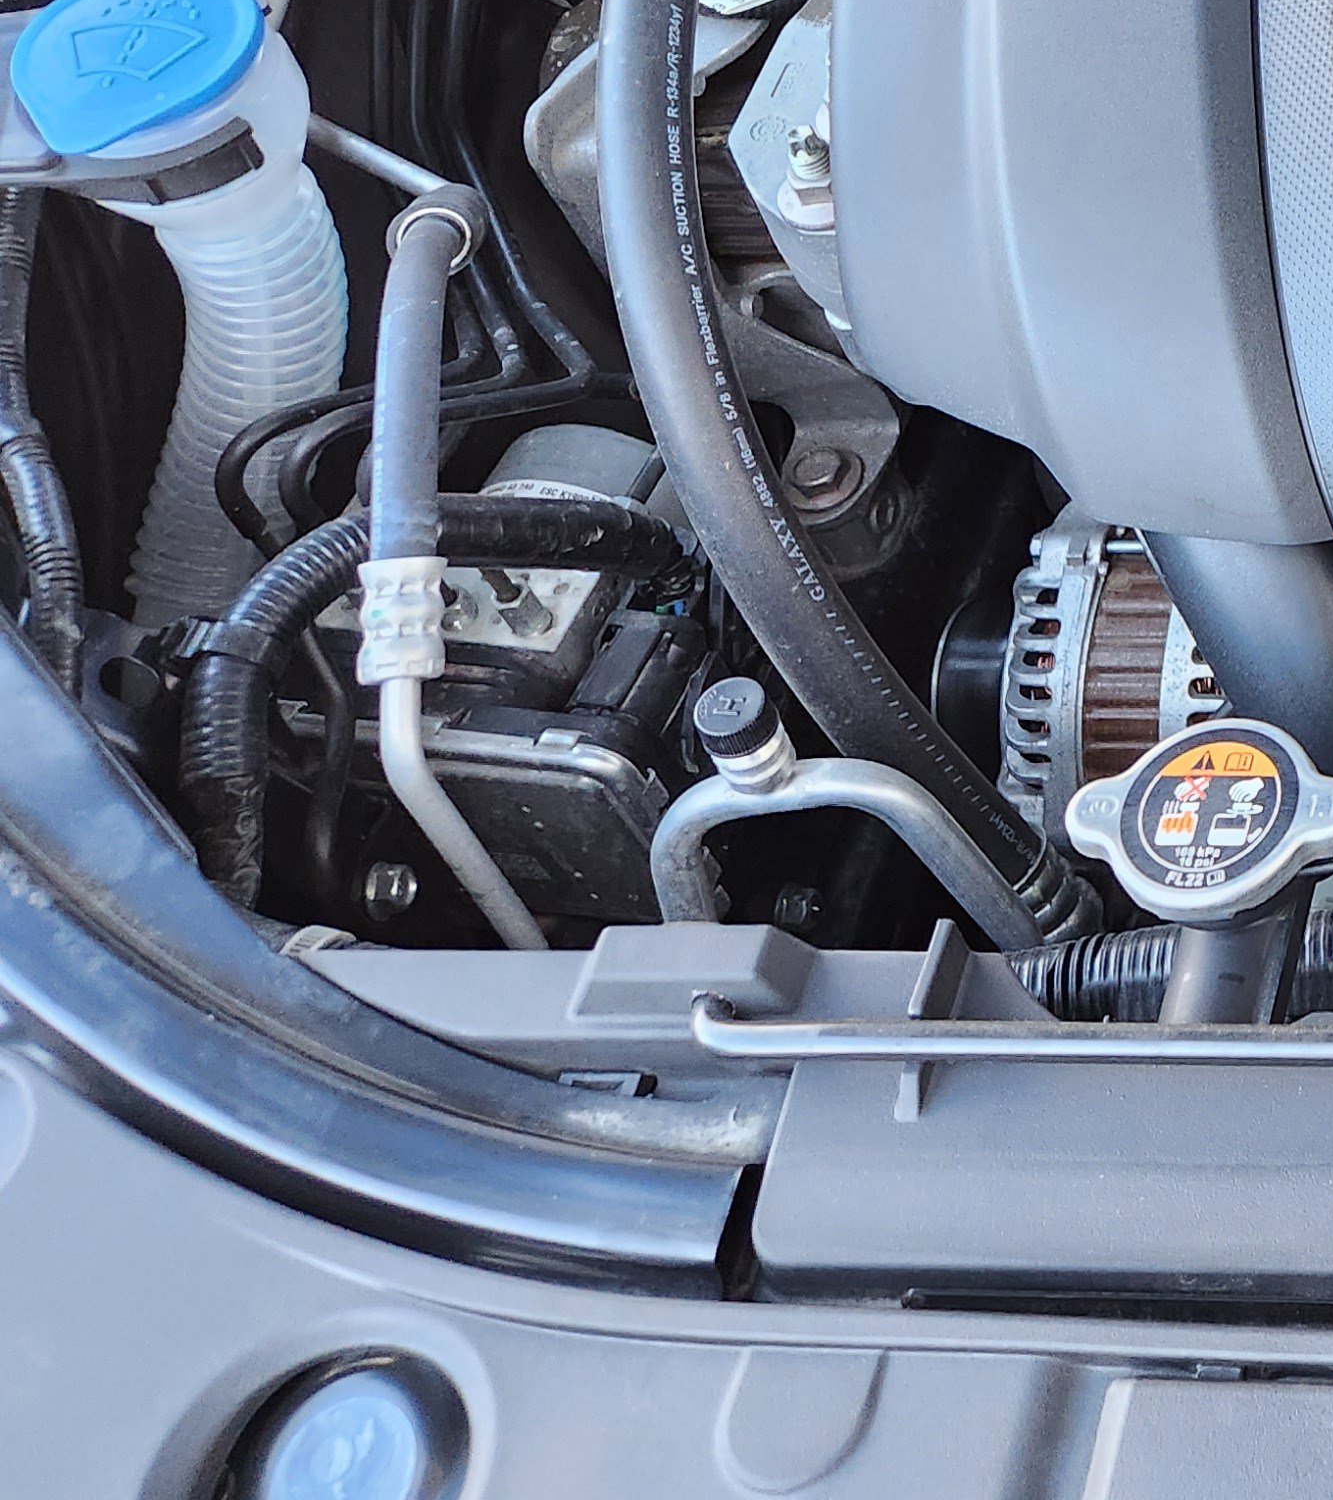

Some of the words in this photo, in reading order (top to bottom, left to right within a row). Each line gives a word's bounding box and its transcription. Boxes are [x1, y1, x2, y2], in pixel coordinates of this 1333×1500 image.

[669, 125, 682, 166] HOSE
[673, 171, 690, 237] SUCTION
[684, 243, 699, 275] A/C
[690, 284, 720, 366] Flexbarrier
[714, 370, 725, 388] in
[719, 392, 738, 422] 5/8
[768, 517, 827, 603] GALAXY
[1196, 845, 1221, 858] kPa
[1165, 870, 1205, 887] FL22
